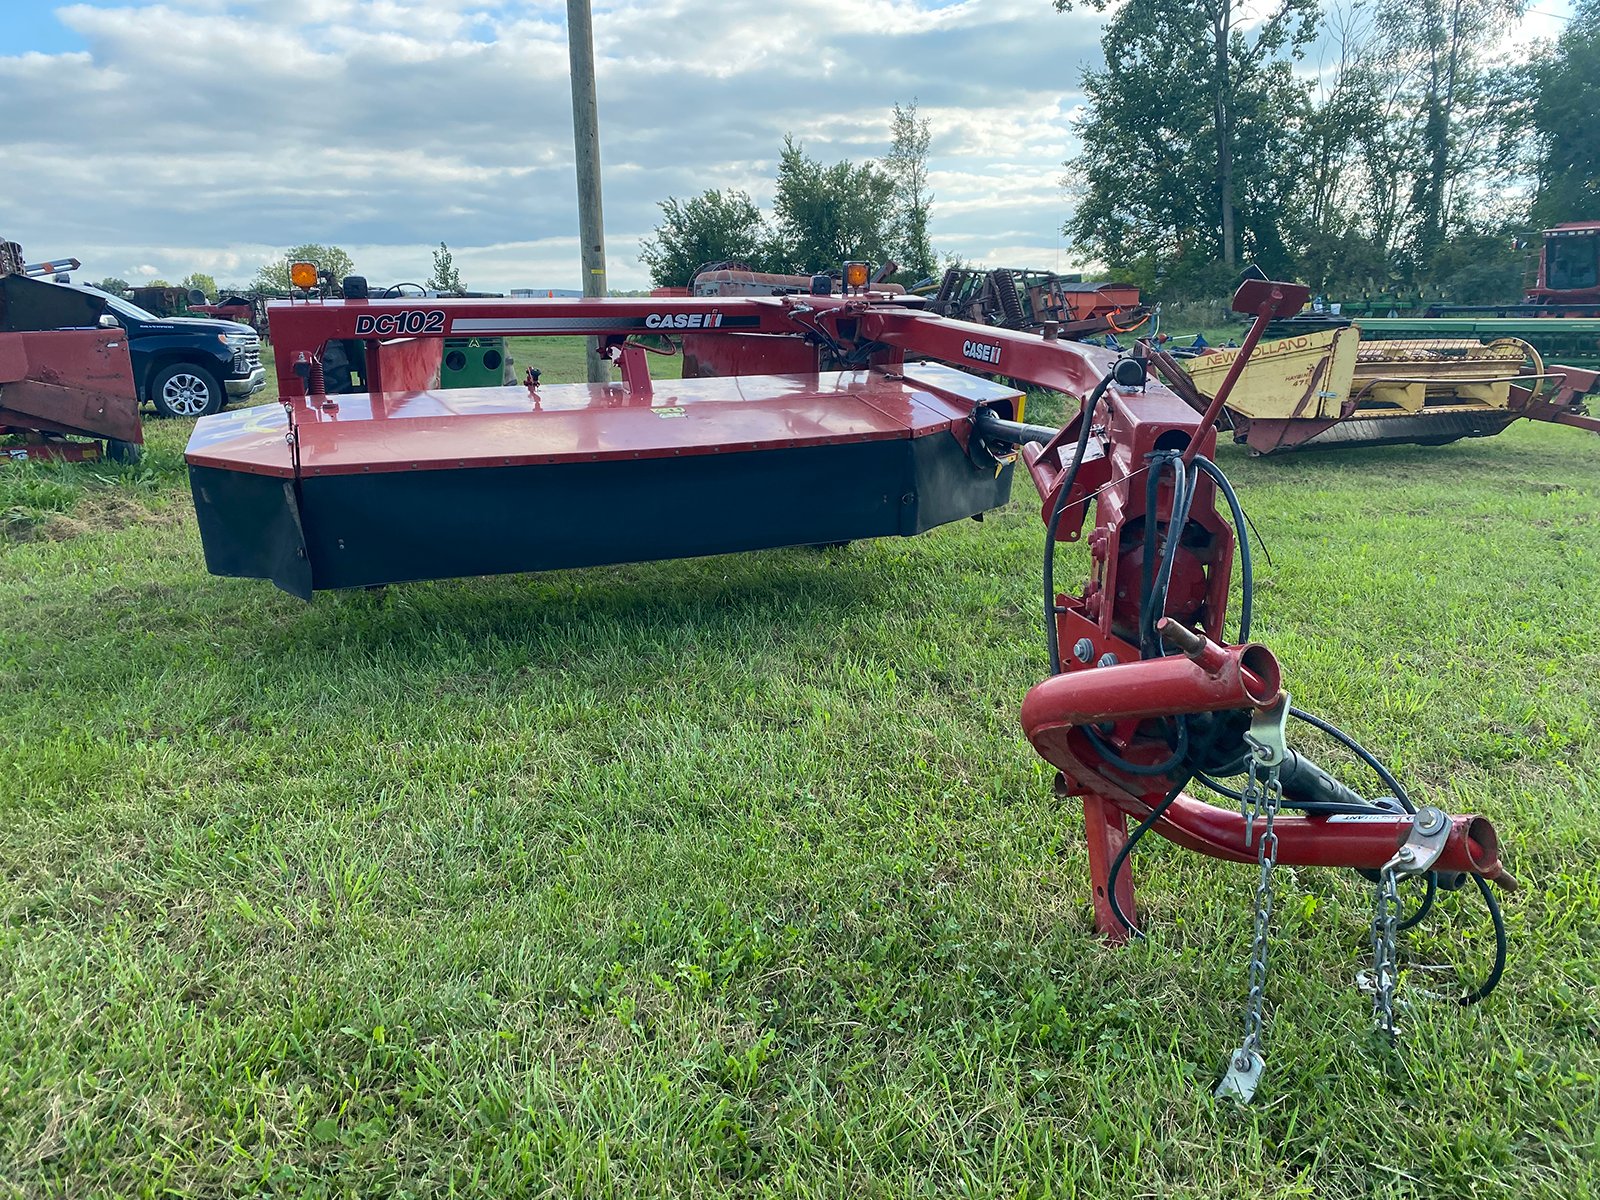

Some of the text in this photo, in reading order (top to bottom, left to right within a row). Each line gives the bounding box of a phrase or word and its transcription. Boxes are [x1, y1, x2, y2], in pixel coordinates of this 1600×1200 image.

[355, 310, 446, 335] DC102
[645, 313, 703, 329] CASE
[962, 340, 991, 362] CASE
[1206, 336, 1308, 366] NEW OLLAND
